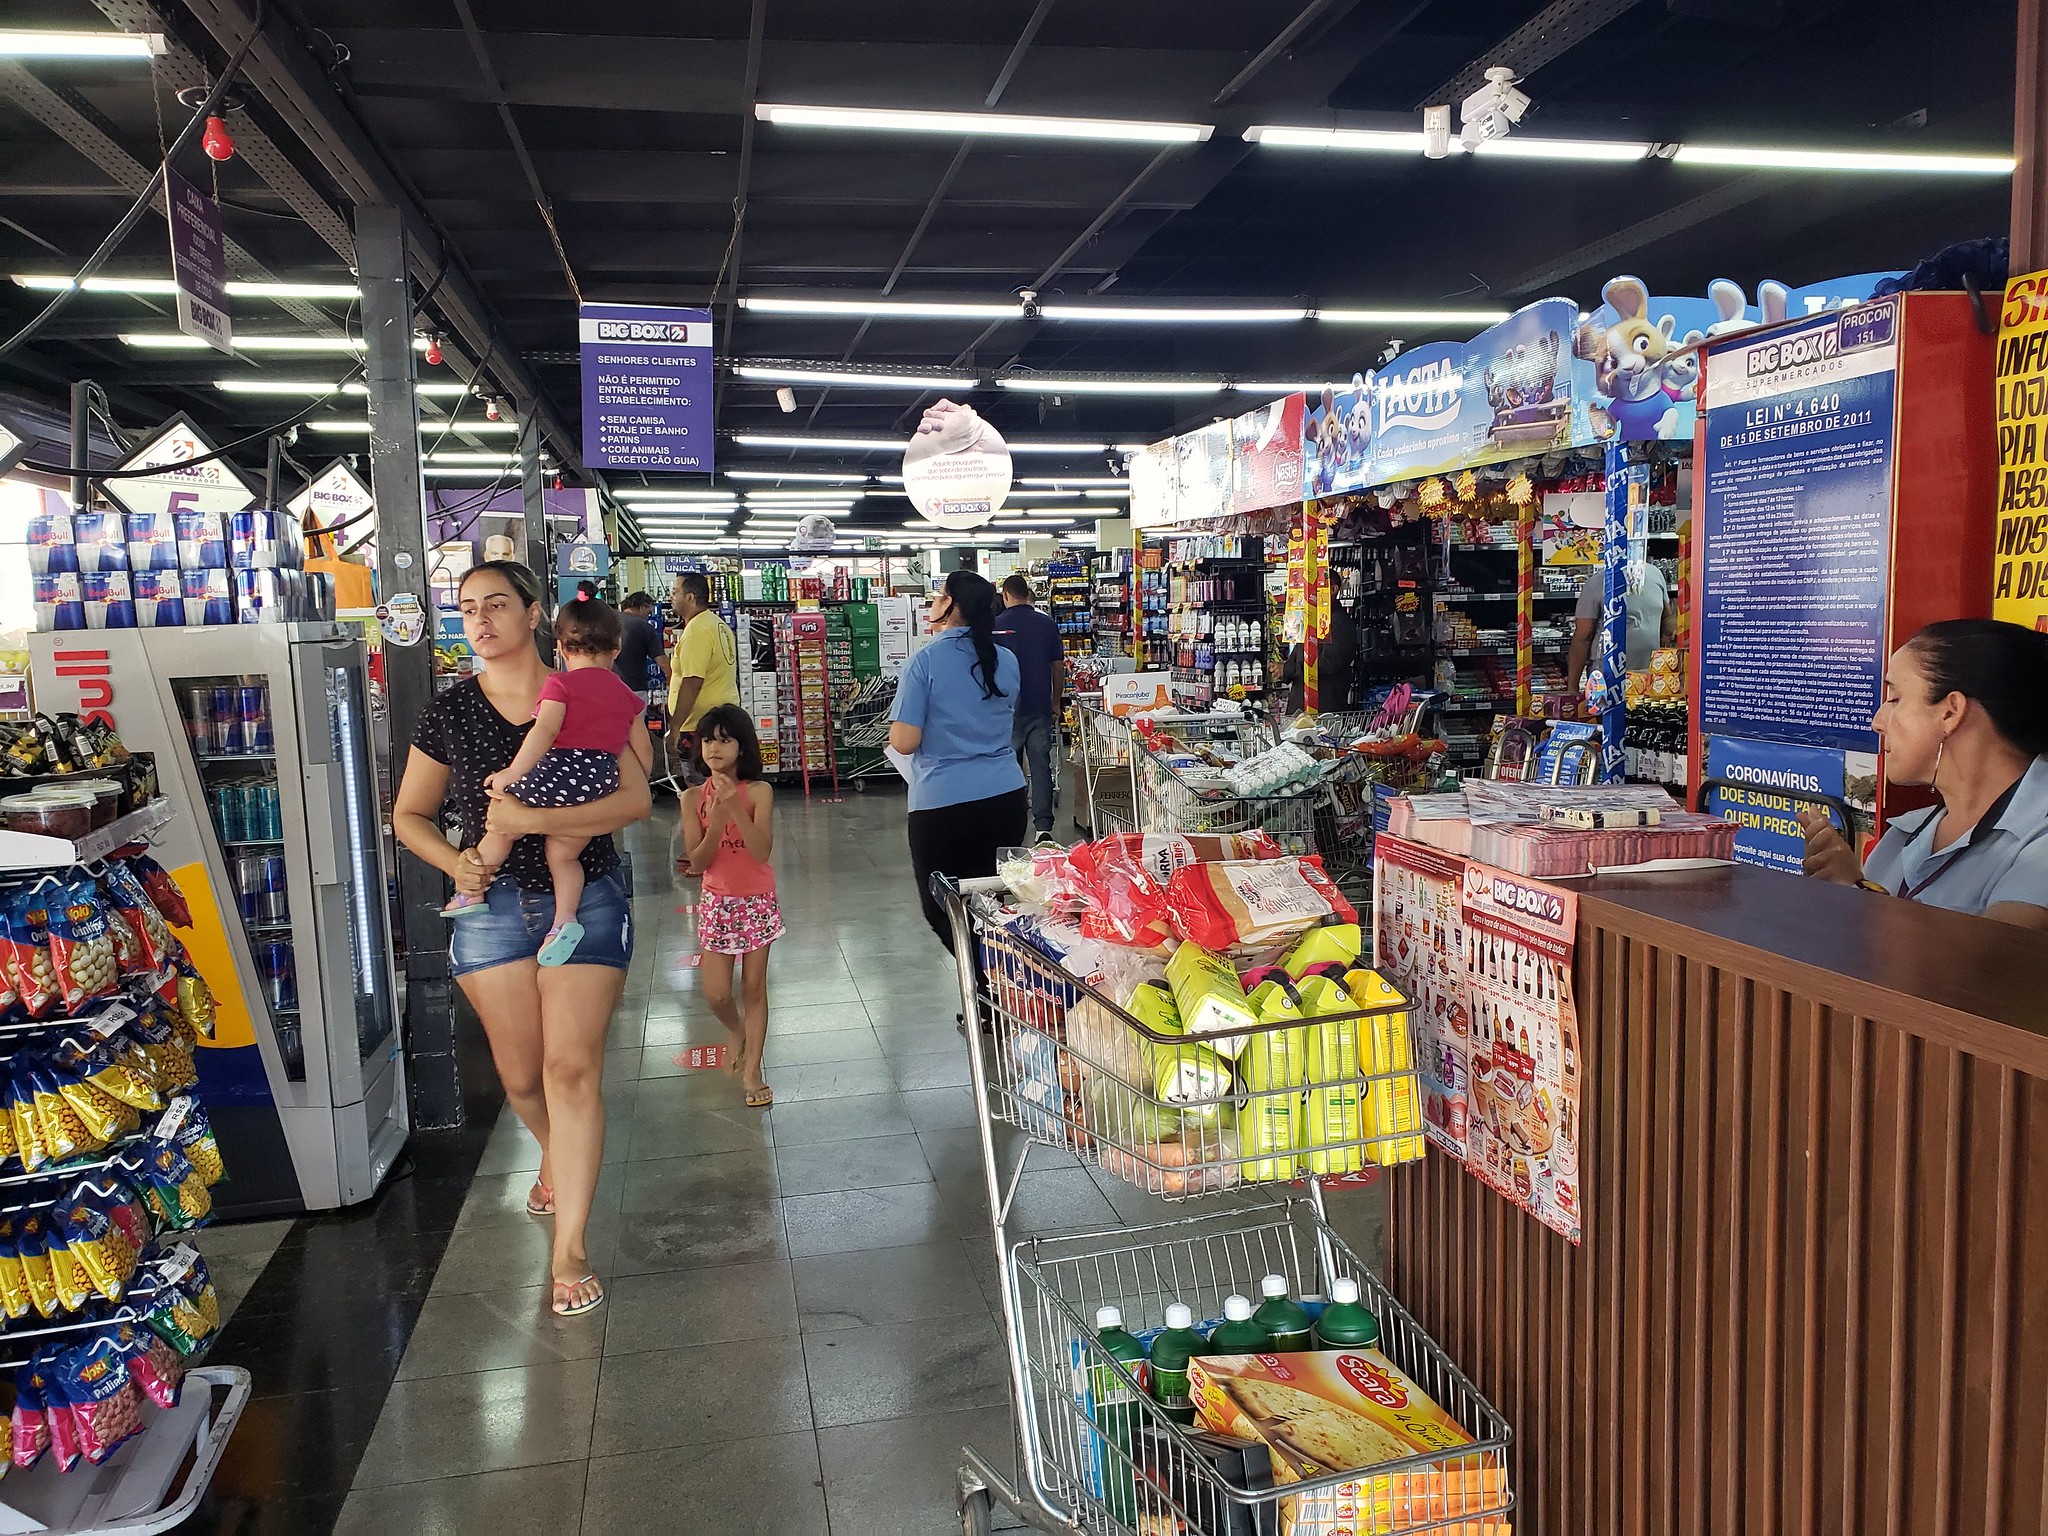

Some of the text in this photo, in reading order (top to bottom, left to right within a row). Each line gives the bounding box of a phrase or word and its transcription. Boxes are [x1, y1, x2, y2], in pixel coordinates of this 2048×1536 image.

[186, 189, 204, 214] CAIXA
[176, 201, 217, 245] PREFERENCIAL
[190, 300, 202, 324] BIG
[1844, 306, 1890, 329] PROCON
[599, 323, 668, 340] BIG BOX
[1858, 331, 1874, 344] 151
[598, 356, 696, 366] SENHORES CLIENTES
[1747, 332, 1822, 378] BIG BOX
[598, 375, 680, 386] NÃO É PERMITIDO
[1746, 360, 1844, 389] SUPERMERCADOS
[598, 386, 670, 395] ENTRAR NESTE
[599, 396, 691, 406] ESTABELECIMENTO:
[1378, 358, 1462, 438] LACTA
[1999, 376, 2048, 422] LOJ
[1746, 394, 1840, 427] LEI Nº 4.640
[607, 416, 665, 425] SEM CAMISA
[607, 426, 637, 434] TRAJE
[655, 427, 688, 435] BANHO
[1720, 410, 1871, 447] DE 15 DE SETEMBRO DE 2011
[608, 436, 640, 444] PATINS
[1378, 448, 1393, 459] Cada
[1428, 433, 1460, 448] aproxima
[2000, 423, 2037, 466] PIA
[608, 446, 670, 454] COM ANIMAIS
[608, 455, 699, 466] (EXCETO CÃO GUIA)
[1276, 460, 1297, 481] Nestlé
[314, 491, 352, 502] BIG BOX
[944, 503, 980, 513] BIG BOX
[50, 531, 68, 540] Bull
[102, 530, 119, 540] Bull
[153, 529, 170, 539] Bull
[202, 528, 218, 537] Bull
[330, 513, 348, 546] 4
[1997, 514, 2048, 556] NOS
[667, 564, 695, 572] ÚNICA
[1996, 562, 2013, 599] A
[57, 589, 74, 598] Bull
[108, 588, 125, 597] Bull
[159, 586, 175, 595] Bull
[1116, 691, 1150, 700] Piracanjuba
[1726, 764, 1822, 792] CORONAVÍRUS.
[1720, 786, 1744, 801] DOE
[1725, 809, 1760, 828] QUEM
[1758, 848, 1771, 859] aqui
[1773, 851, 1785, 862] sua
[1494, 879, 1516, 908] BIG
[1516, 885, 1548, 918] BOX
[1340, 1358, 1397, 1405] Seara
